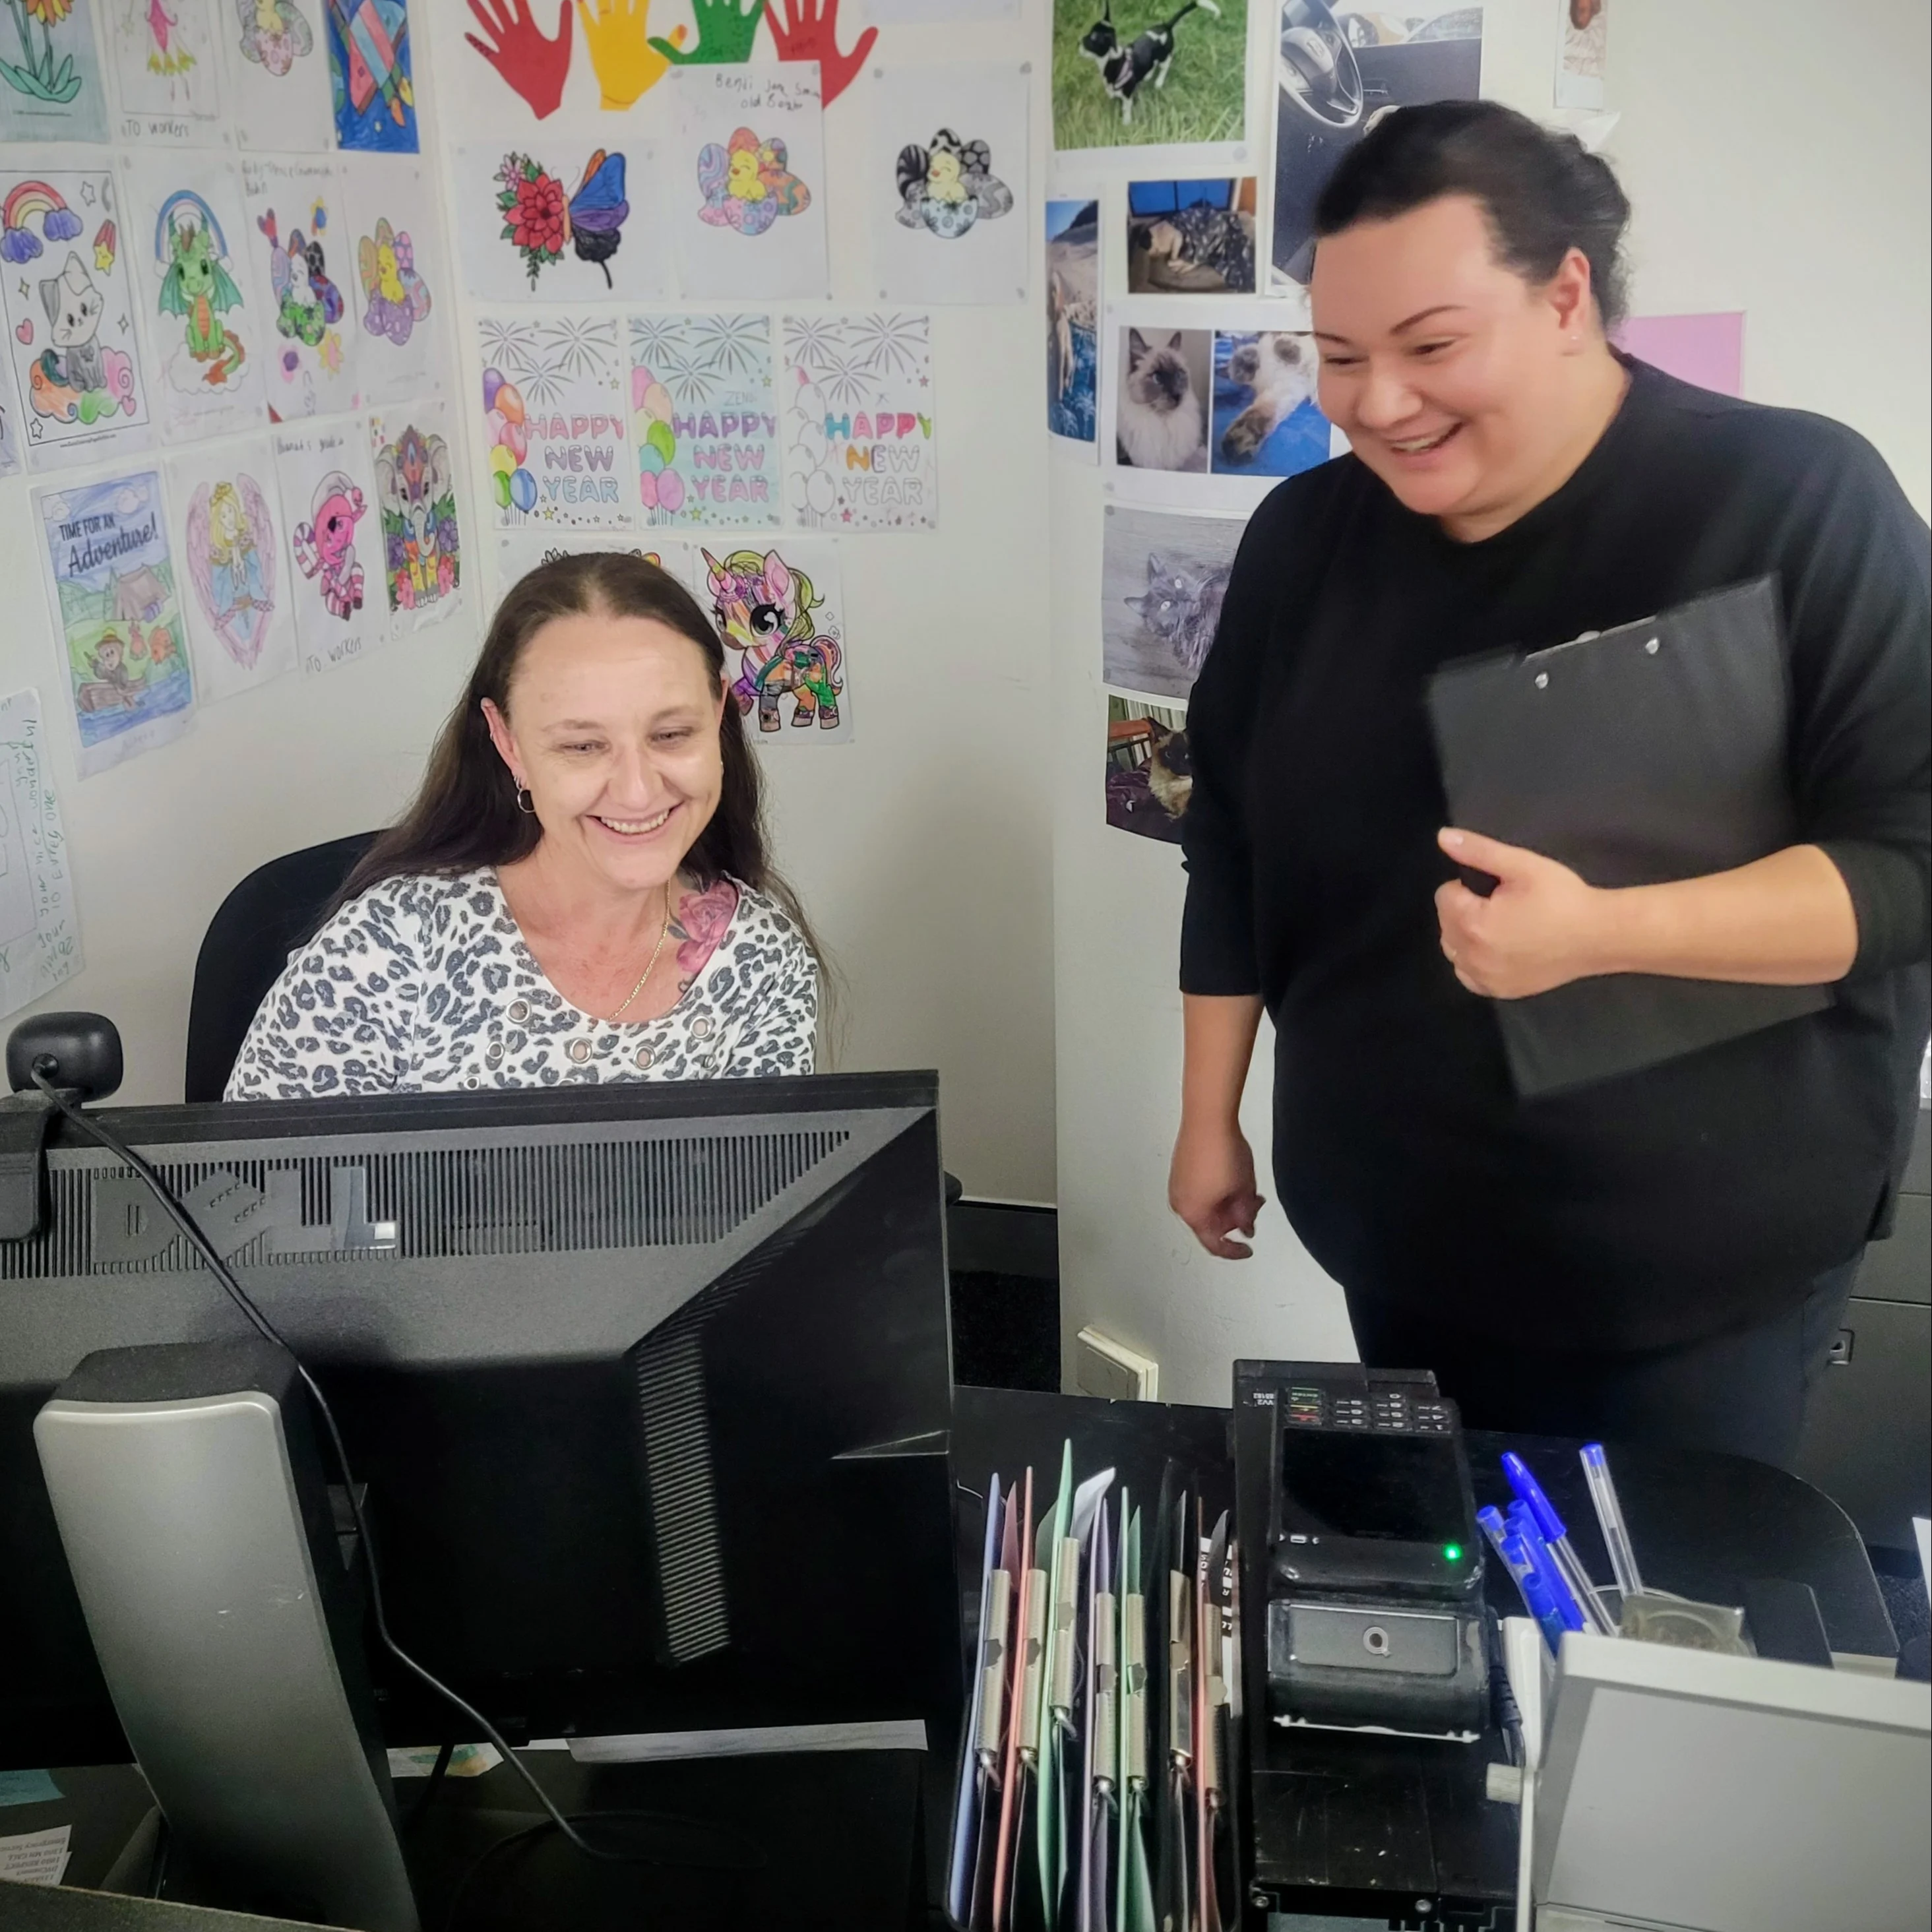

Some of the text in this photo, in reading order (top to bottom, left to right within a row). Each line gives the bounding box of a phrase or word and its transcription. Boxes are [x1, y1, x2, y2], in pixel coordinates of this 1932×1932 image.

[524, 413, 624, 440] HAPPY
[672, 410, 776, 439] HAPPY
[825, 411, 932, 440] HAPPY
[544, 445, 613, 472] NEW
[693, 443, 765, 472] NEW
[846, 444, 920, 473] NEW
[542, 476, 619, 503] YEAR
[690, 474, 770, 503] YEAR
[842, 476, 923, 506] YEAR
[59, 520, 82, 542] TIME
[82, 515, 102, 536] FOR
[69, 511, 160, 578] Adventure!
